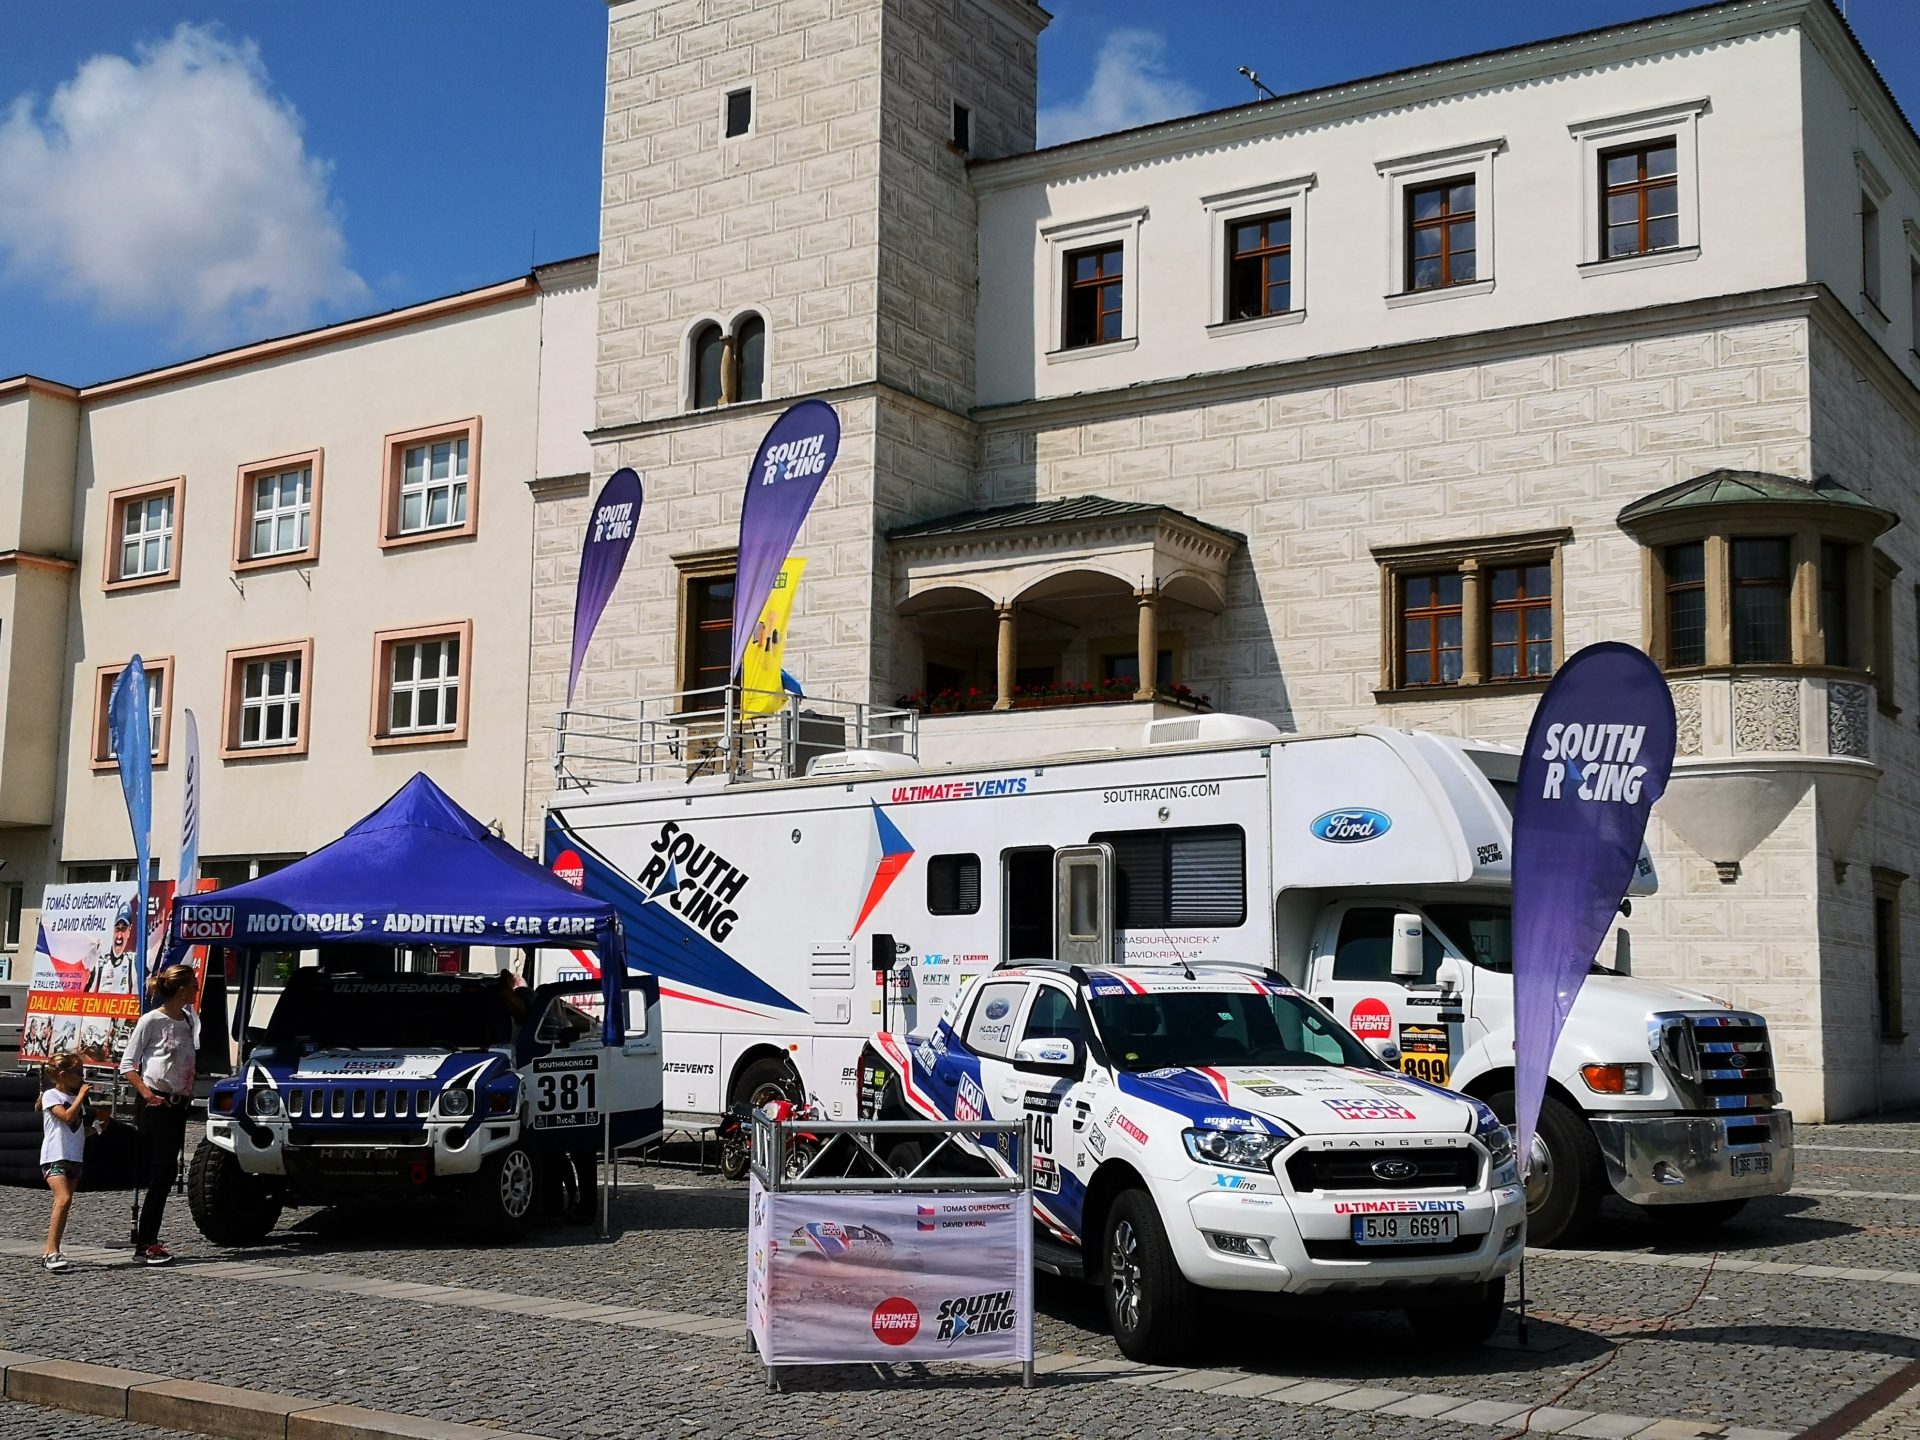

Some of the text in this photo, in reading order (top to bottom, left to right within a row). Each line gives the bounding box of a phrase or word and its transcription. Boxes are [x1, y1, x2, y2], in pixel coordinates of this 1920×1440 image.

[763, 434, 825, 466] SOUTH
[595, 503, 633, 524] SOUTH
[1542, 723, 1647, 763] SOUTH
[1103, 784, 1220, 803] SOUTHRACING.COM
[1325, 813, 1375, 838] Ford
[1477, 843, 1498, 856] SOUTH
[650, 821, 750, 905] SOUTH
[46, 892, 121, 910] TOMÁŠ OUŘEDNÍČEK
[57, 918, 80, 931] DAVID
[80, 915, 106, 931] KŘÍPAL
[185, 908, 231, 921] LIQUI
[183, 923, 231, 936] MOLY
[247, 913, 595, 935] MOTOROILS ADDITIVES CAR CARE
[29, 995, 51, 1010] DALI
[52, 996, 79, 1012] JSME
[82, 997, 102, 1013] TEN
[1351, 1022, 1390, 1031] EVENTS
[1352, 1014, 1391, 1022] ULTIMATE
[538, 1059, 593, 1069] SOUTHRACING.CZ
[1404, 1058, 1445, 1084] 899
[538, 1073, 596, 1112] 381
[960, 1075, 983, 1113] LIQUI
[1324, 1099, 1400, 1108] LIQUI
[1203, 1116, 1251, 1126] agados
[1336, 1108, 1410, 1119] MOLY
[1026, 1113, 1053, 1154] 40
[1322, 1138, 1457, 1147] RANGER
[1212, 1174, 1257, 1190] XTline
[968, 1203, 1010, 1212] OUREDNICEK
[1367, 1216, 1449, 1238] 5J9 6691
[937, 1290, 1012, 1320] SOUTH
[874, 1321, 917, 1329] EVENTS
[875, 1313, 918, 1321] ULTIMATE
